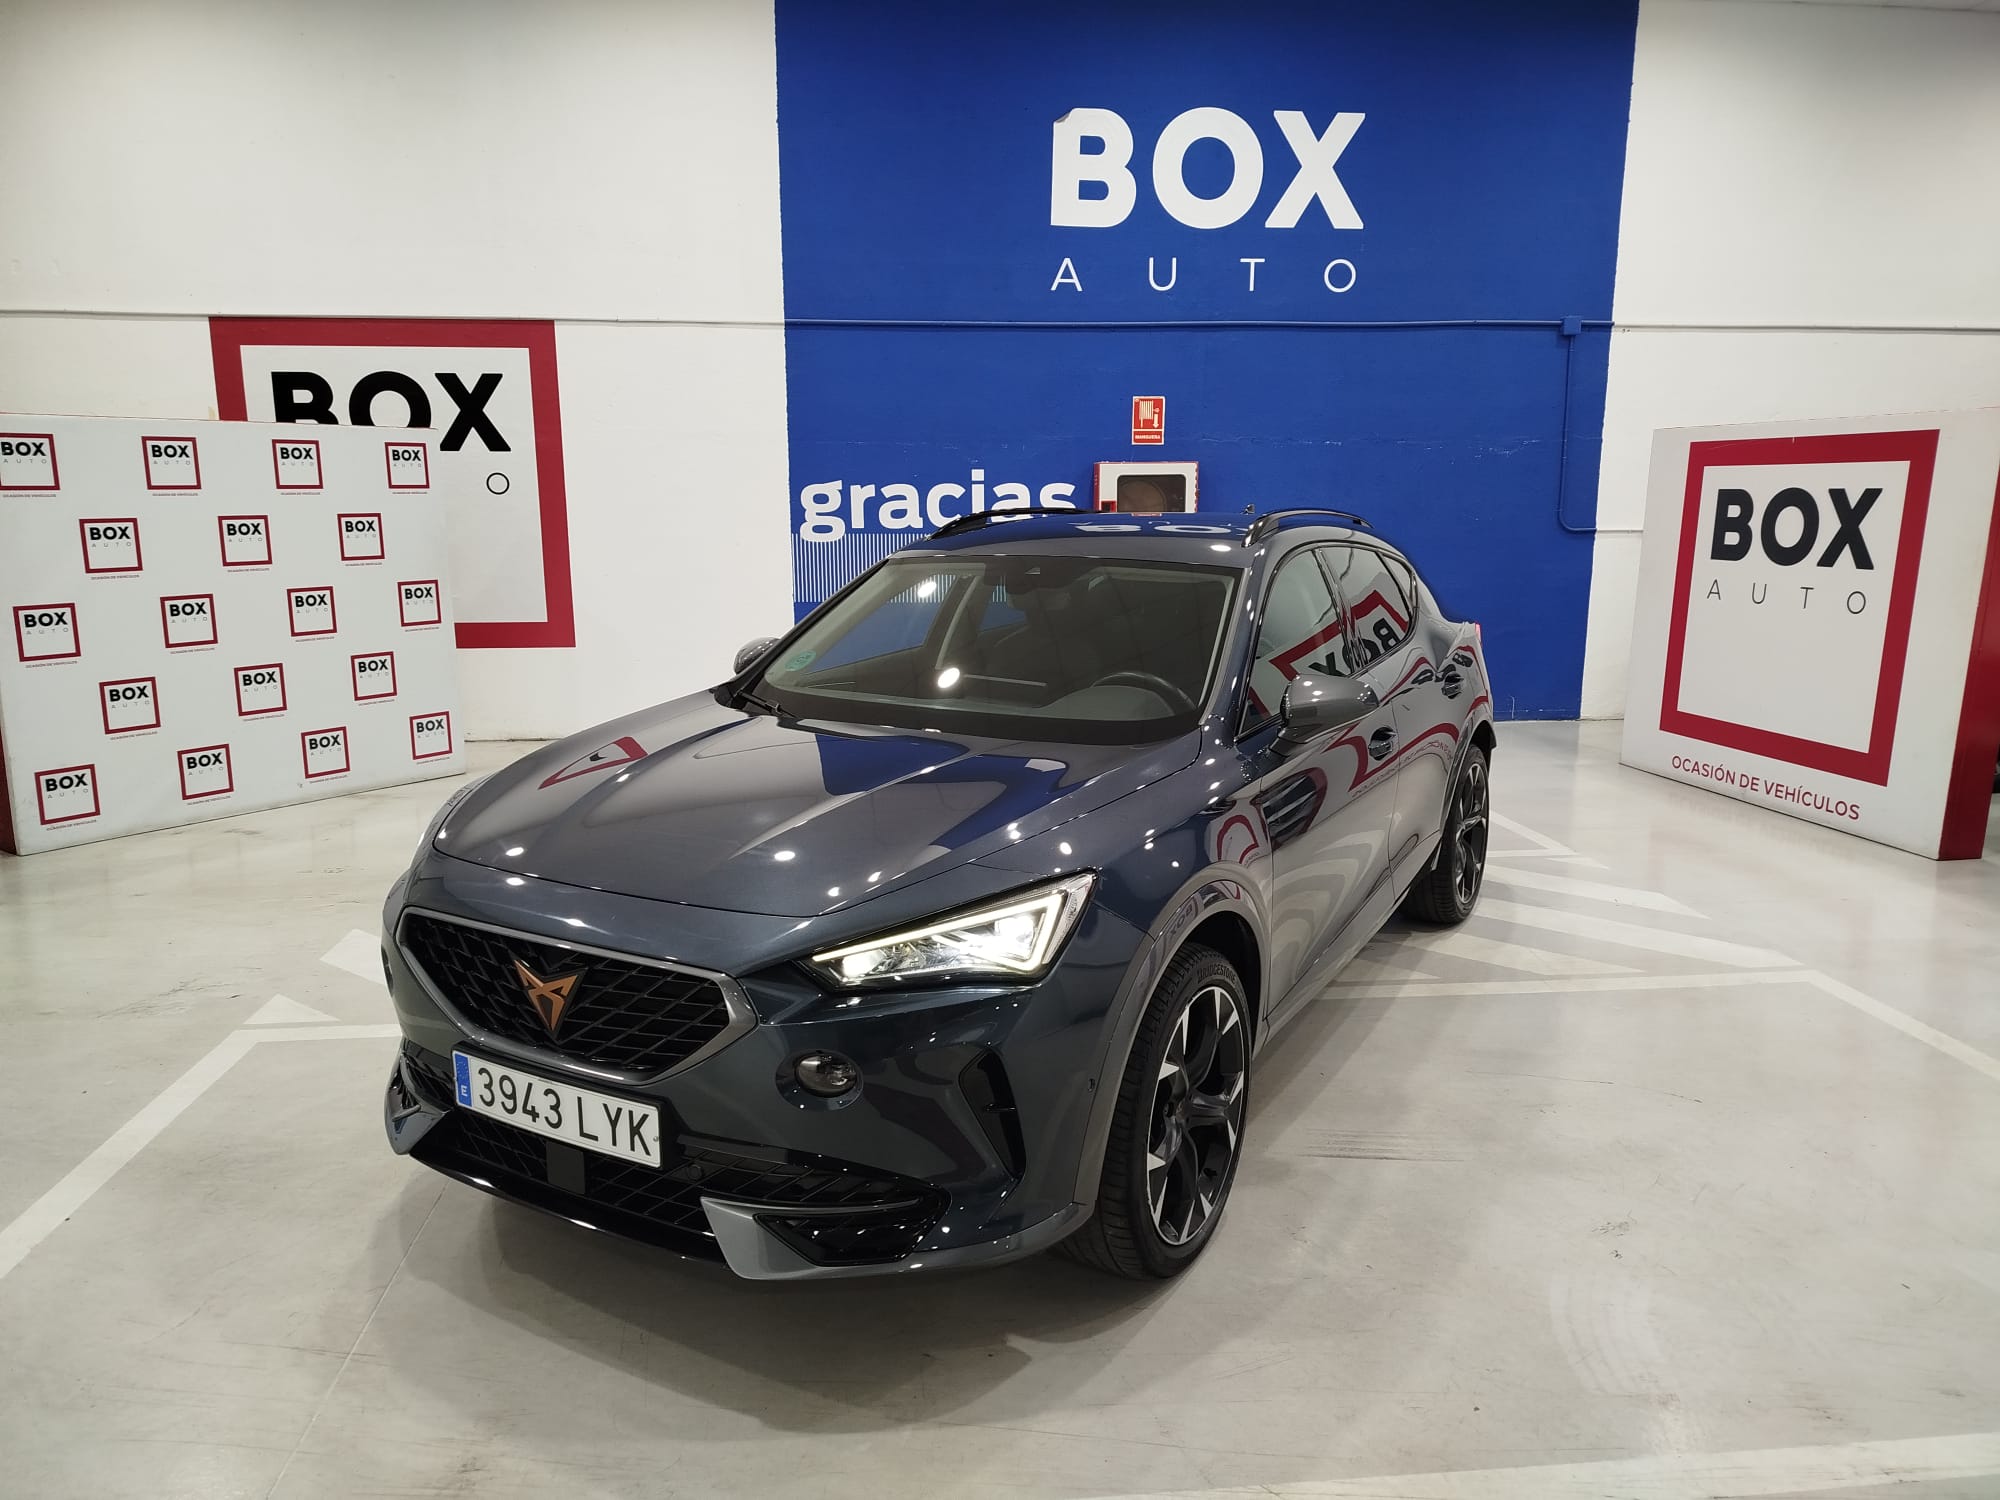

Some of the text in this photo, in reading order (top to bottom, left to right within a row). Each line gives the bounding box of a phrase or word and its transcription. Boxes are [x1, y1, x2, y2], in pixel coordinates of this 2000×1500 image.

[1050, 107, 1365, 229] BOX
[1050, 257, 1357, 293] AUTO
[271, 371, 511, 452] BOX
[1, 442, 46, 456] BOX
[151, 445, 189, 458] BOX
[280, 447, 313, 459] BOX
[392, 450, 421, 461] BOX
[800, 469, 1076, 542] gracias
[90, 526, 130, 540] BOX
[227, 523, 261, 536] BOX
[345, 520, 375, 532] BOX
[1711, 487, 1883, 570] BOX
[295, 594, 327, 607] BOX
[405, 587, 432, 599] BOX
[1707, 579, 1866, 614] AUTO
[170, 602, 206, 617] BOX
[24, 612, 67, 627] BOX
[358, 659, 388, 672] BOX
[243, 671, 276, 686] BOX
[109, 686, 149, 702] BOX
[417, 719, 444, 733] BOX
[309, 735, 341, 750] BOX
[187, 753, 222, 769] BOX
[45, 773, 87, 792] BOX
[1671, 755, 1861, 820] OCASIÓN DE VEHÍCULOS
[460, 1085, 468, 1097] E
[478, 1067, 652, 1156] 3943 LYK
